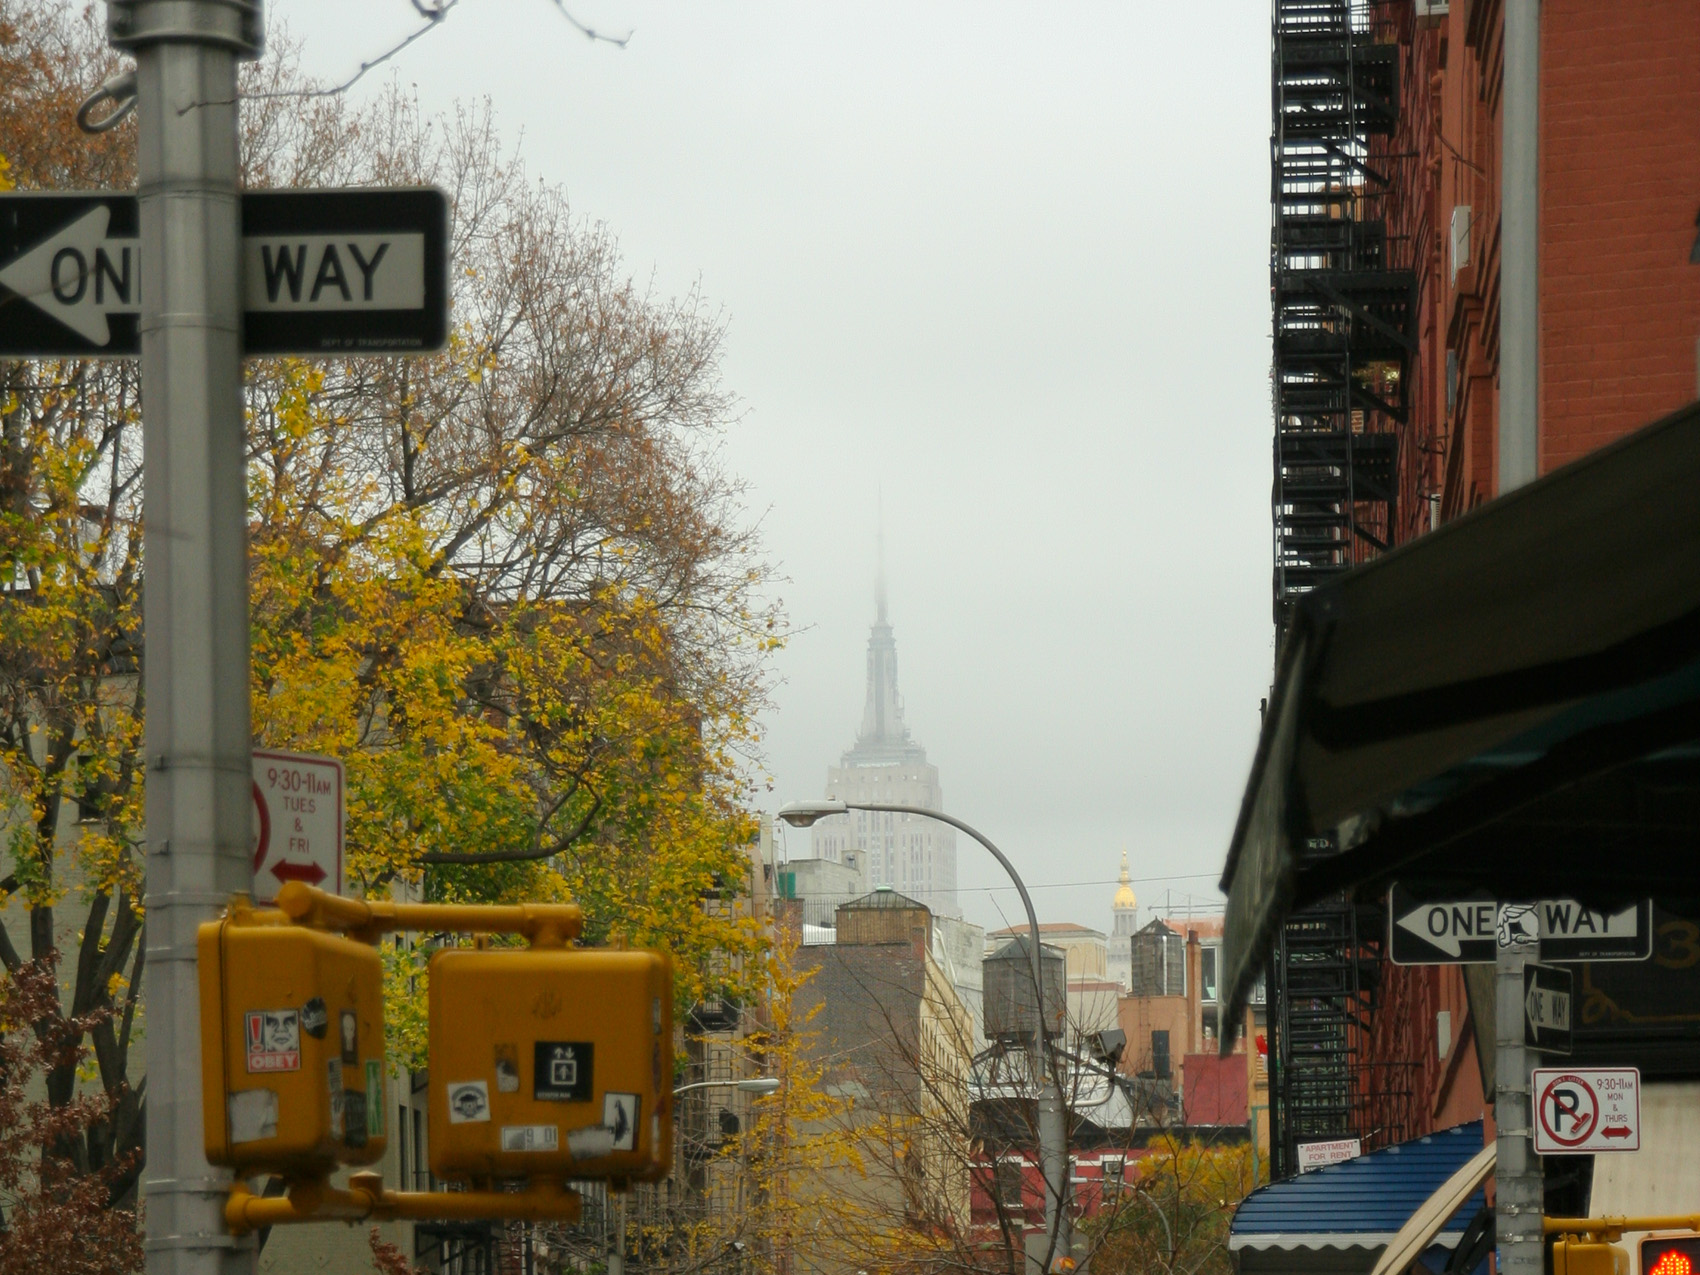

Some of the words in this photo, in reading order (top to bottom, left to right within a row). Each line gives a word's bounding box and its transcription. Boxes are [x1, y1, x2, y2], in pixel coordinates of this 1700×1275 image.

[51, 246, 141, 306] ON
[261, 243, 391, 304] WAY
[268, 768, 331, 795] 9:30-11AM
[282, 796, 316, 813] TUES
[295, 818, 303, 832] &
[289, 838, 309, 854] FRI
[1428, 906, 1494, 937] ONE
[1545, 904, 1612, 934] WAY
[1531, 991, 1544, 1023] ONE
[1551, 995, 1566, 1026] WAY
[251, 1055, 297, 1069] OBEY
[1597, 1078, 1633, 1090] 9:30-11AM
[1607, 1093, 1623, 1101] MON
[1613, 1104, 1618, 1112] &
[1605, 1114, 1628, 1122] THURS
[1306, 1142, 1354, 1152] APARTMENT
[1309, 1153, 1326, 1161] FOR
[1330, 1151, 1352, 1159] RENT
